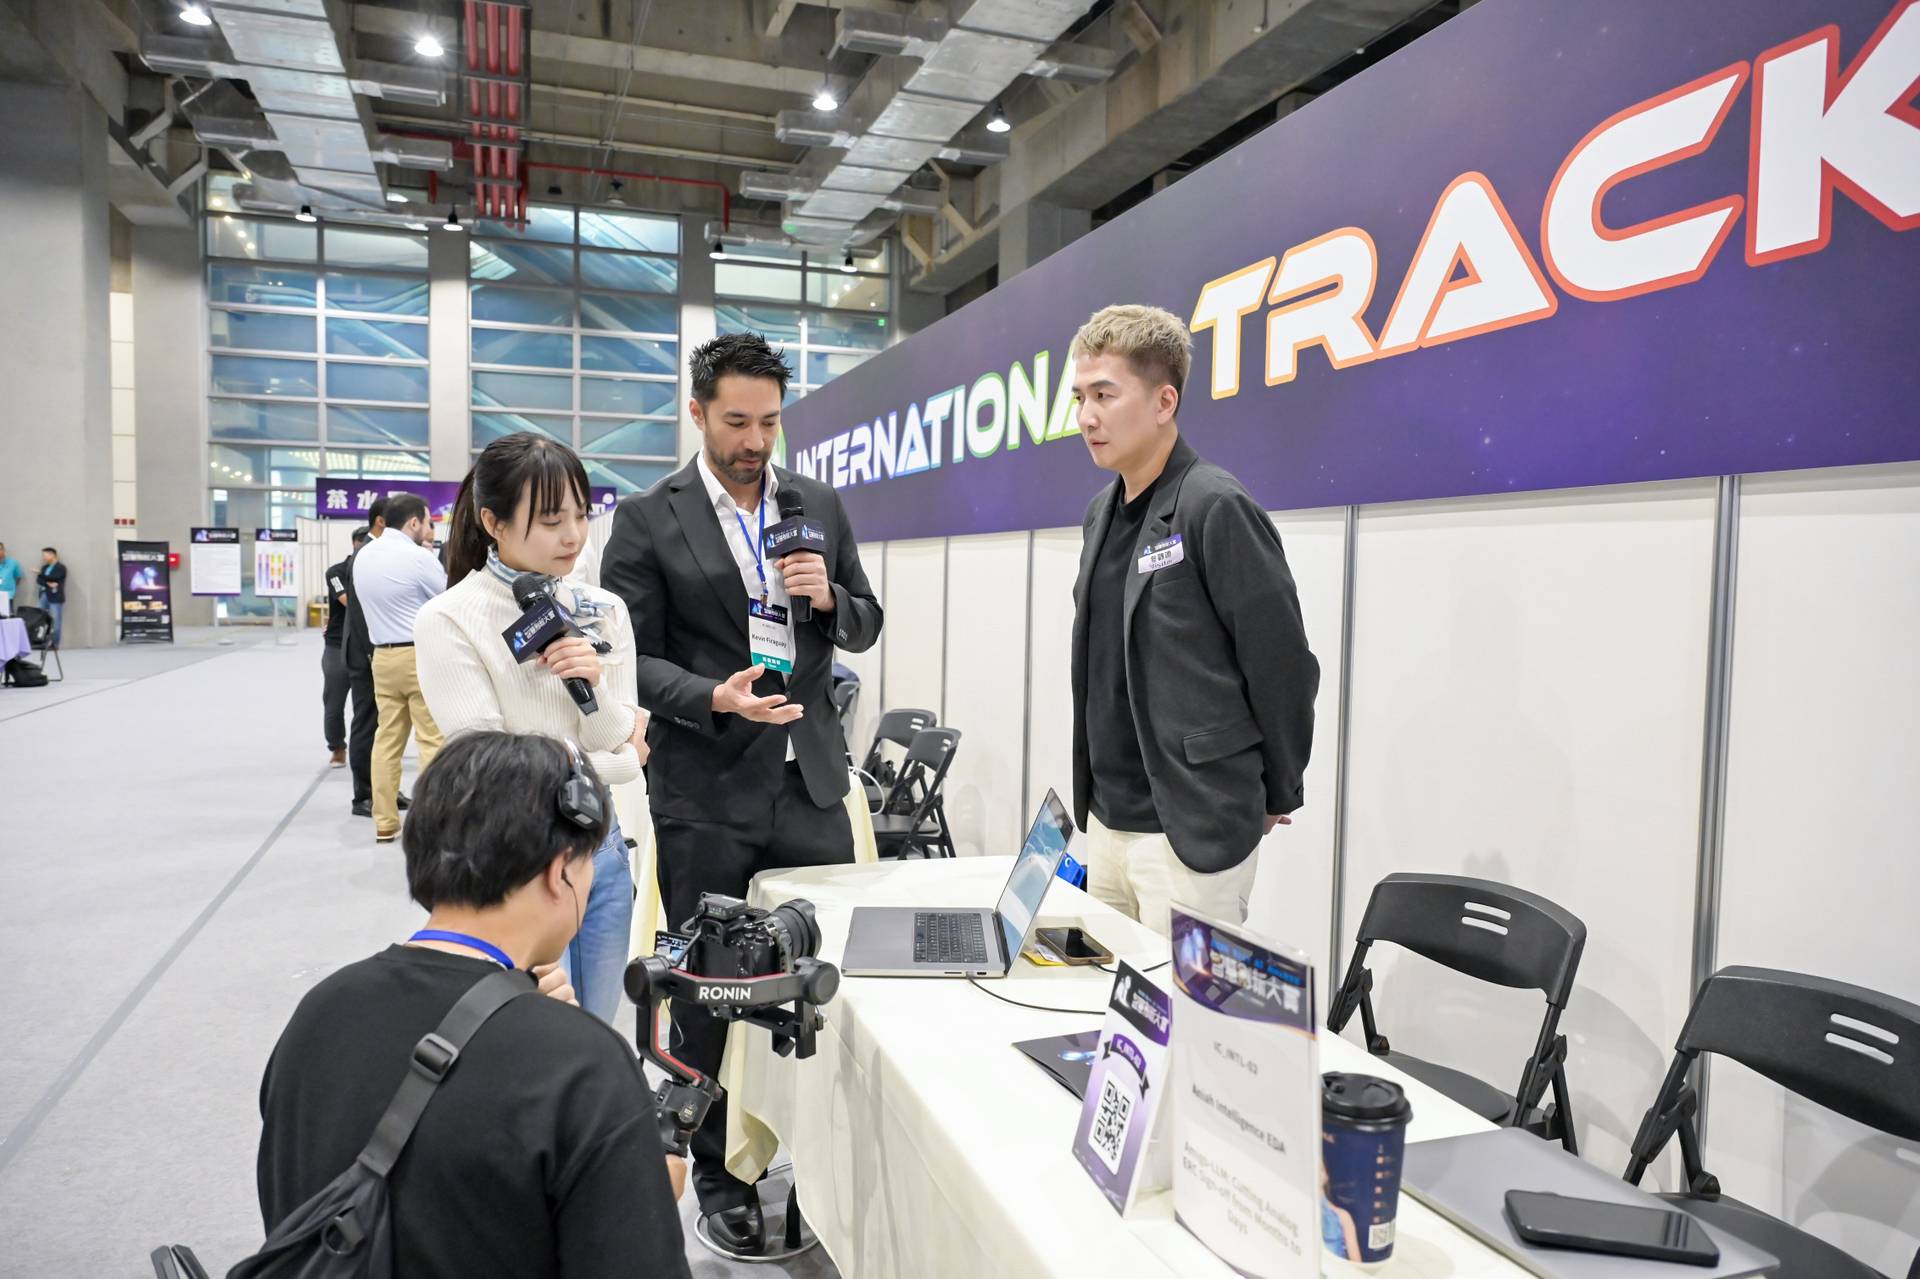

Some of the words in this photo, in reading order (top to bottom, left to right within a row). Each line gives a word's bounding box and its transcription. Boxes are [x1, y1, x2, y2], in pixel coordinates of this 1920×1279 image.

[796, 349, 1082, 488] INTERNATIONA
[1190, 0, 1920, 399] TRACK
[326, 489, 409, 510] 茶水
[699, 986, 751, 1001] RONIN
